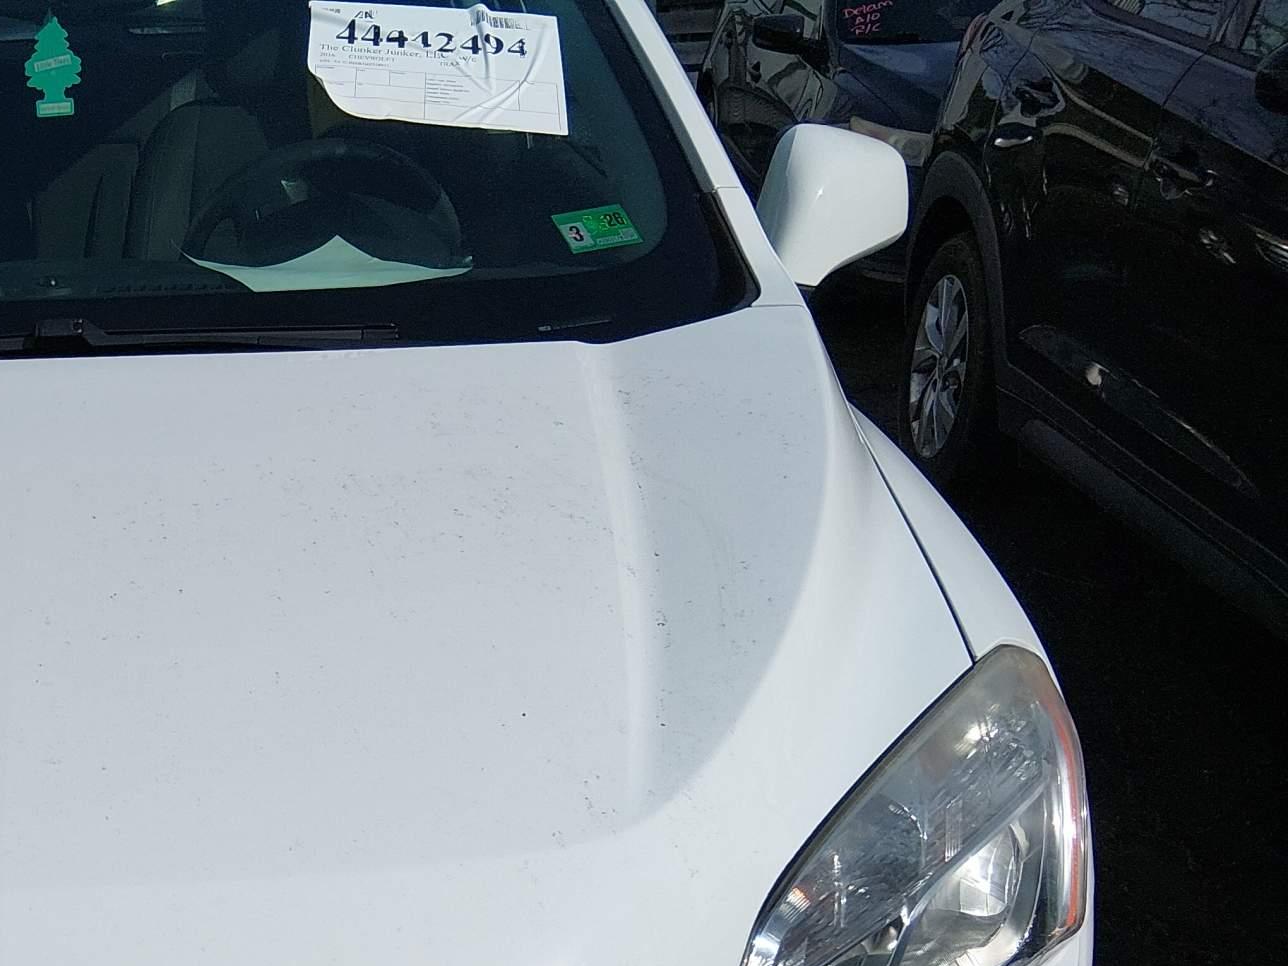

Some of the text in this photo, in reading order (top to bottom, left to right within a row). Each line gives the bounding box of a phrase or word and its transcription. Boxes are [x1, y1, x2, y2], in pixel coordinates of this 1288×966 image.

[320, 43, 339, 51] The
[342, 45, 381, 55] Clunker
[604, 212, 626, 227] 26
[569, 226, 585, 242] 3
